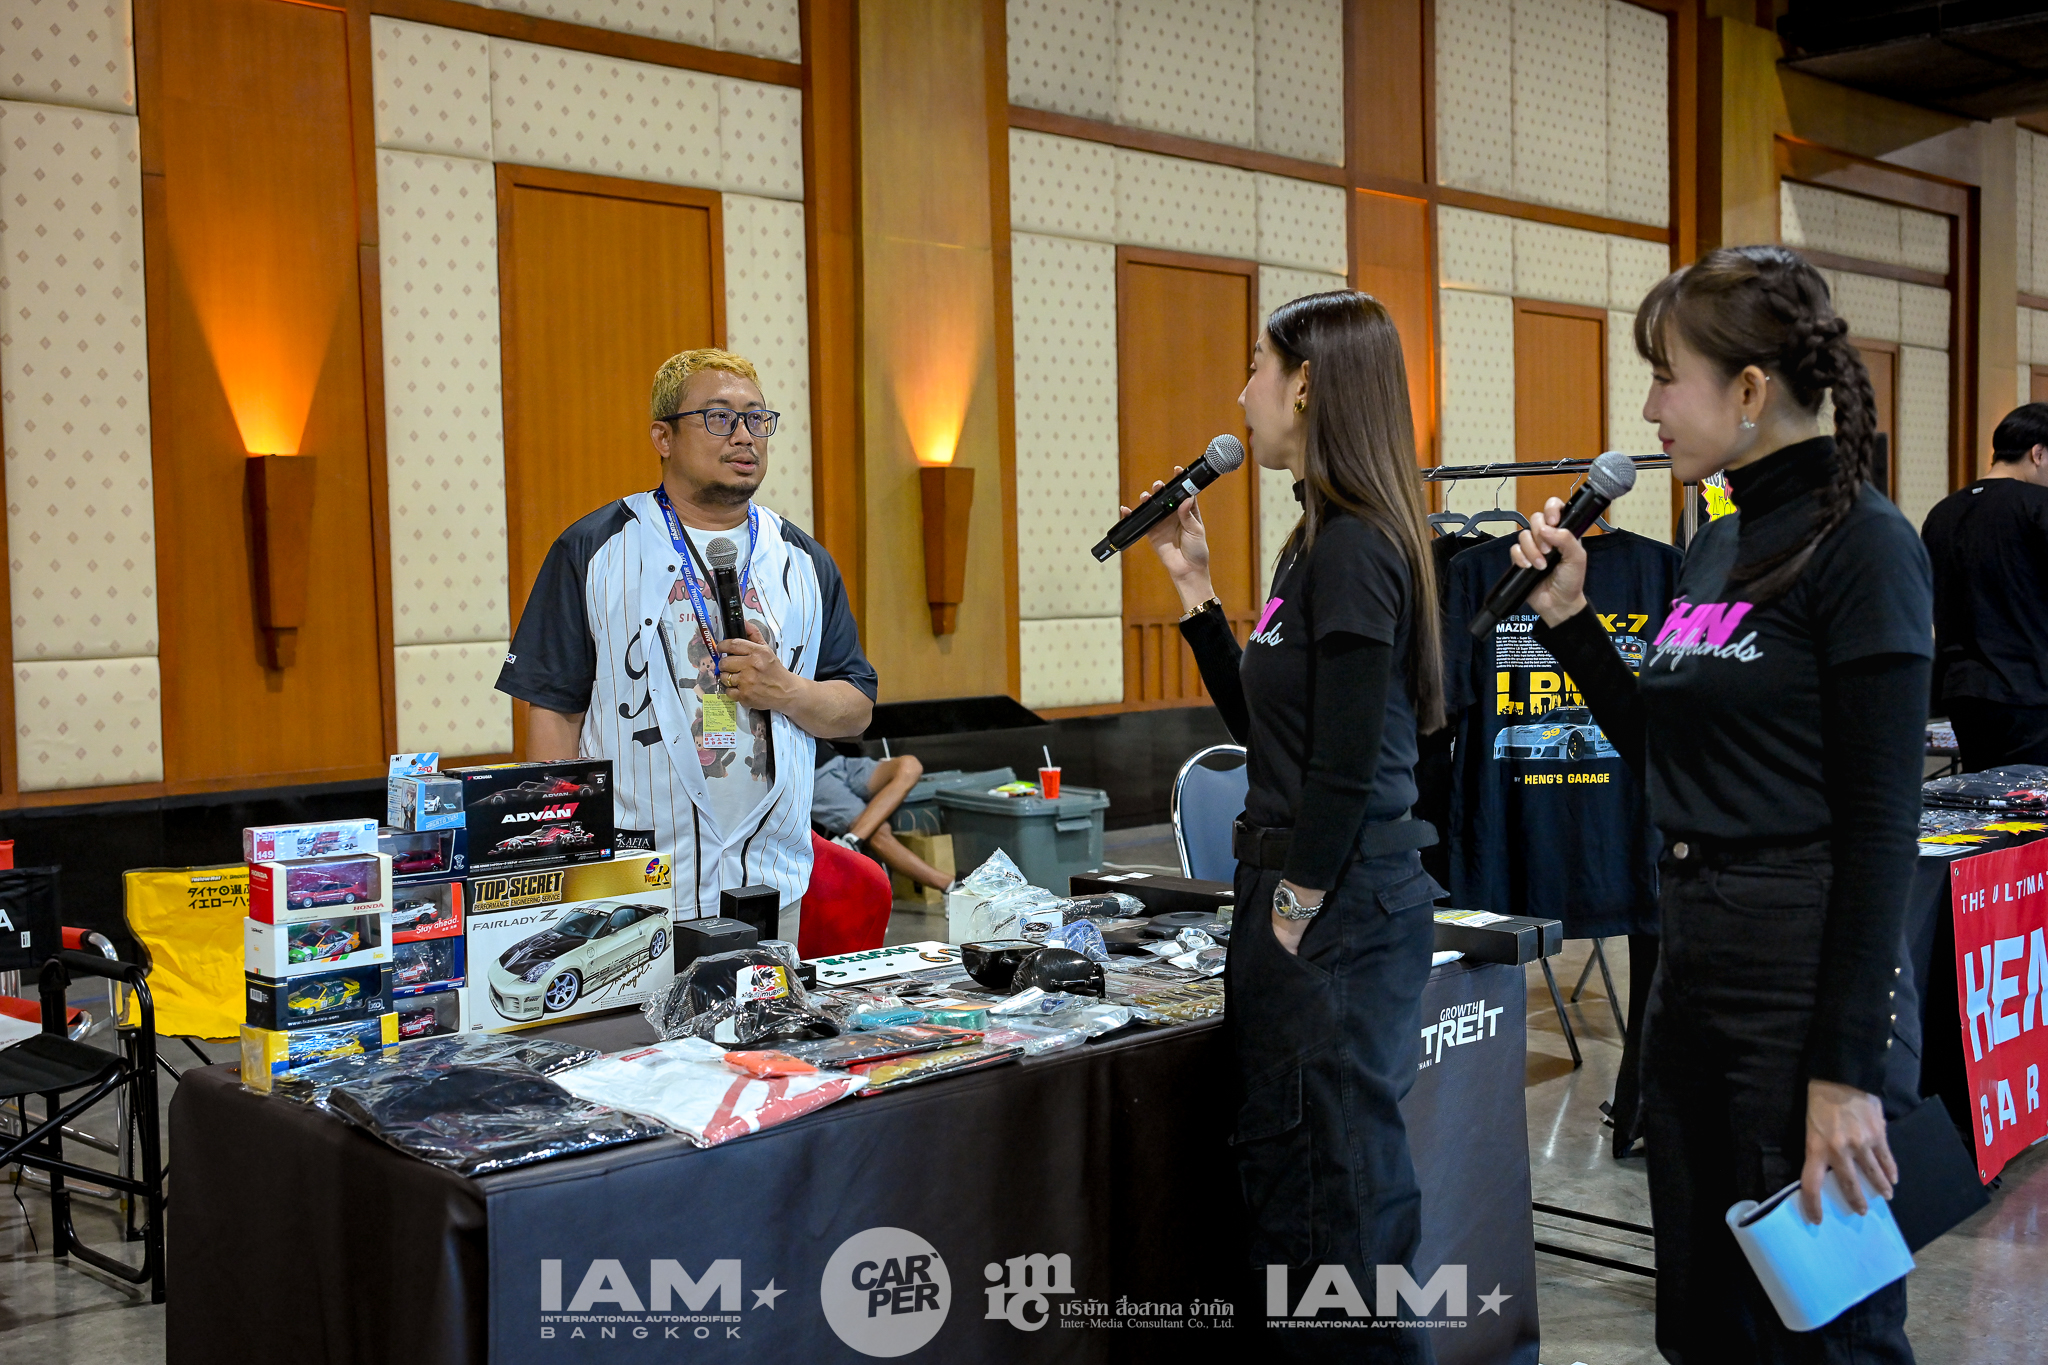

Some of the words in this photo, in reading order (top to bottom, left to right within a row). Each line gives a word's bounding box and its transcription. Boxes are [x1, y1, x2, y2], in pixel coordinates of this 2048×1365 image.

[1520, 614, 1541, 622] SILH
[1596, 613, 1649, 633] X-7
[1496, 622, 1534, 633] MAZDA
[1541, 727, 1561, 740] 39
[1524, 774, 1563, 785] HENG'S
[1567, 773, 1610, 784] GARAGE
[542, 791, 569, 799] ADVAN
[501, 808, 572, 824] ADVAN
[256, 850, 274, 860] 149
[475, 878, 508, 902] TOP
[509, 871, 565, 899] SECRET
[1961, 888, 1985, 914] THE
[1992, 870, 2048, 904] ULTIMA
[353, 903, 385, 911] HONDA
[473, 901, 510, 911] PERFORMANCE
[510, 897, 541, 907] ENGINEERING
[541, 893, 561, 902] SERVICE
[416, 922, 433, 934] Stay
[434, 914, 460, 929] ahead.
[473, 915, 538, 931] FAIRLADY
[538, 908, 559, 923] Z
[1440, 1001, 1479, 1022] GROWTH
